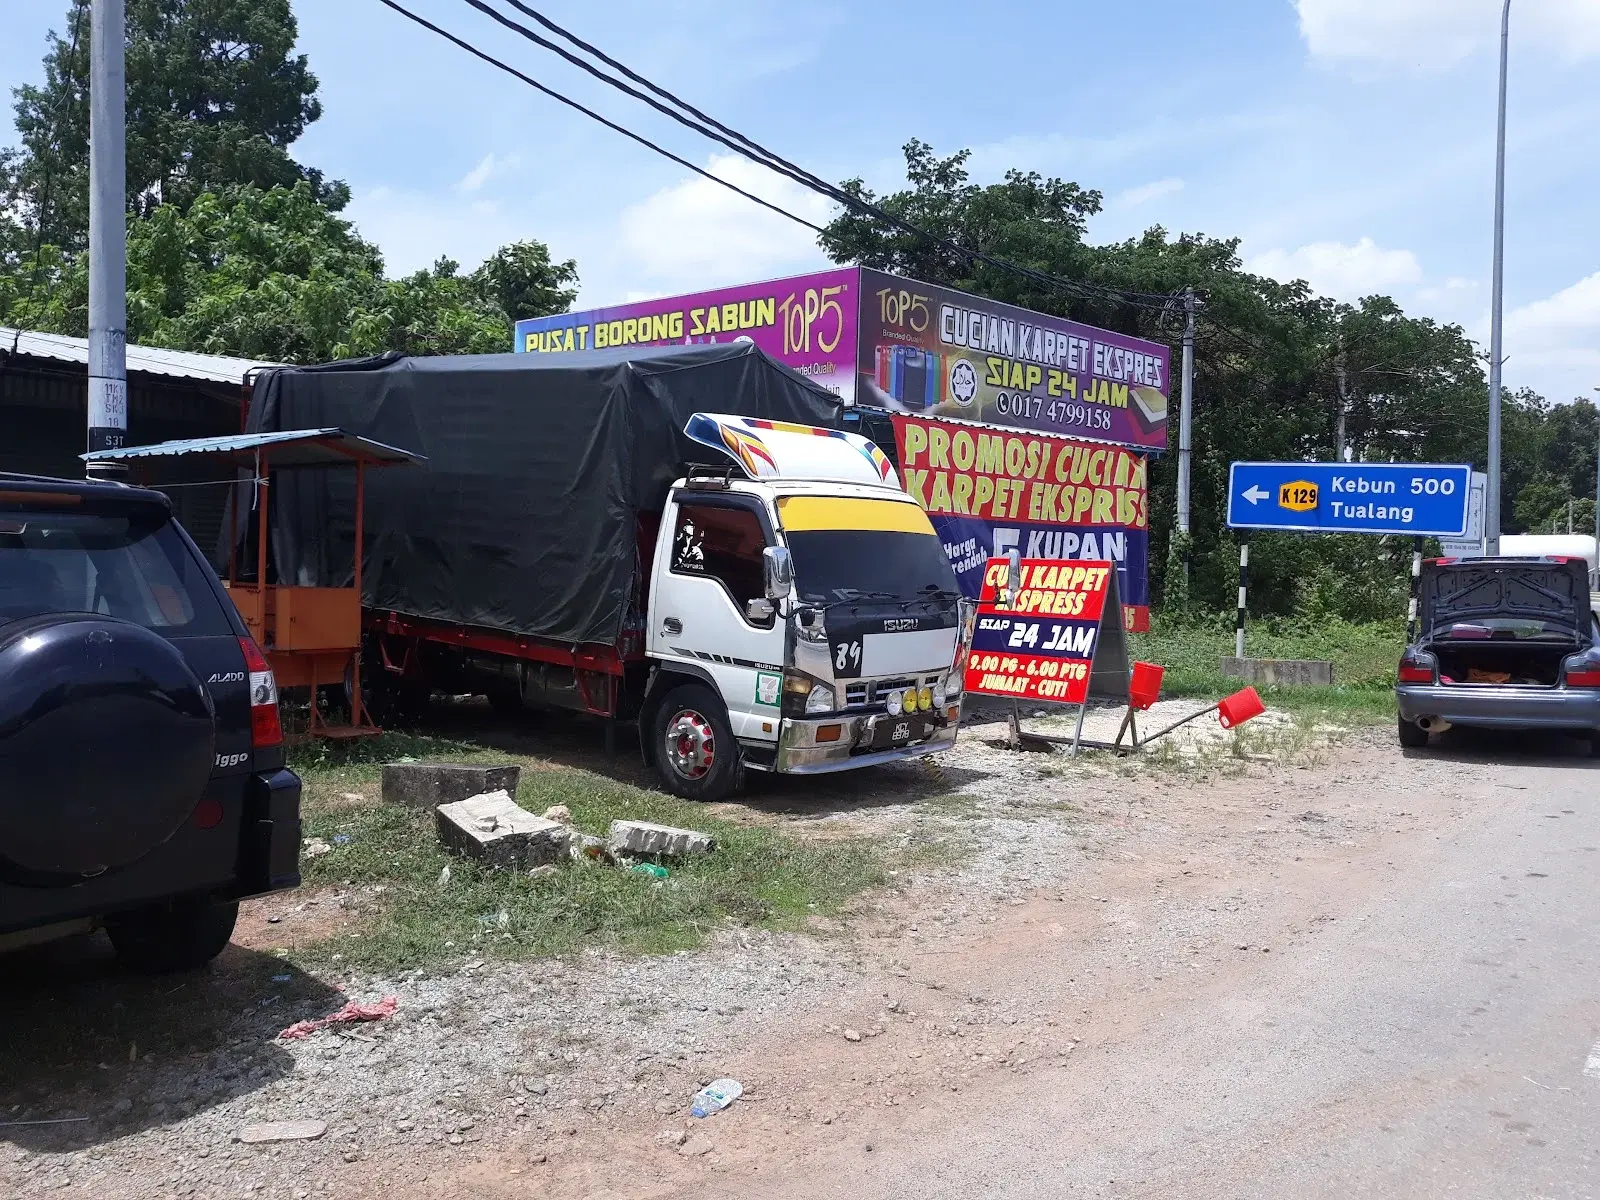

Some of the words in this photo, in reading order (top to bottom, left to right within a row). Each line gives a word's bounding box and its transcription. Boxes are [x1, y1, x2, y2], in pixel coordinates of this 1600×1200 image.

[525, 326, 588, 352] PUSAT
[594, 310, 685, 349] BORONG
[690, 297, 776, 336] SABUN
[882, 328, 906, 341] Branded
[939, 304, 1015, 358] CUCIAN
[1017, 322, 1090, 374] KARPET
[1092, 341, 1163, 390] EKSPRES
[813, 362, 836, 375] Quality
[986, 357, 1042, 394] SIAP
[1048, 370, 1077, 401] 24
[1082, 381, 1129, 408] JAM
[1011, 393, 1042, 418] 017
[1047, 399, 1111, 431] 4799158
[904, 423, 1051, 479] PROMOSI
[904, 468, 1024, 518] KARPET
[1331, 476, 1396, 494] Kebun
[1410, 478, 1455, 495] 500
[1331, 502, 1414, 522] Tualang
[951, 546, 988, 575] rendah
[986, 564, 1030, 588] CUI
[1029, 565, 1108, 591] KARPET
[883, 618, 920, 632] ISUZU
[978, 618, 1011, 631] SIAP
[1008, 622, 1040, 649] 24
[1042, 625, 1095, 657] JAM
[207, 671, 245, 683] ALADO
[754, 662, 773, 670] ISUZU
[969, 655, 999, 672] 9.00
[1000, 658, 1018, 674] PG
[1026, 660, 1059, 677] 6.00
[1059, 662, 1087, 680] PTG
[978, 673, 1030, 694] JUMAAT
[1037, 679, 1069, 698] CUTI
[214, 752, 249, 767] iggo
